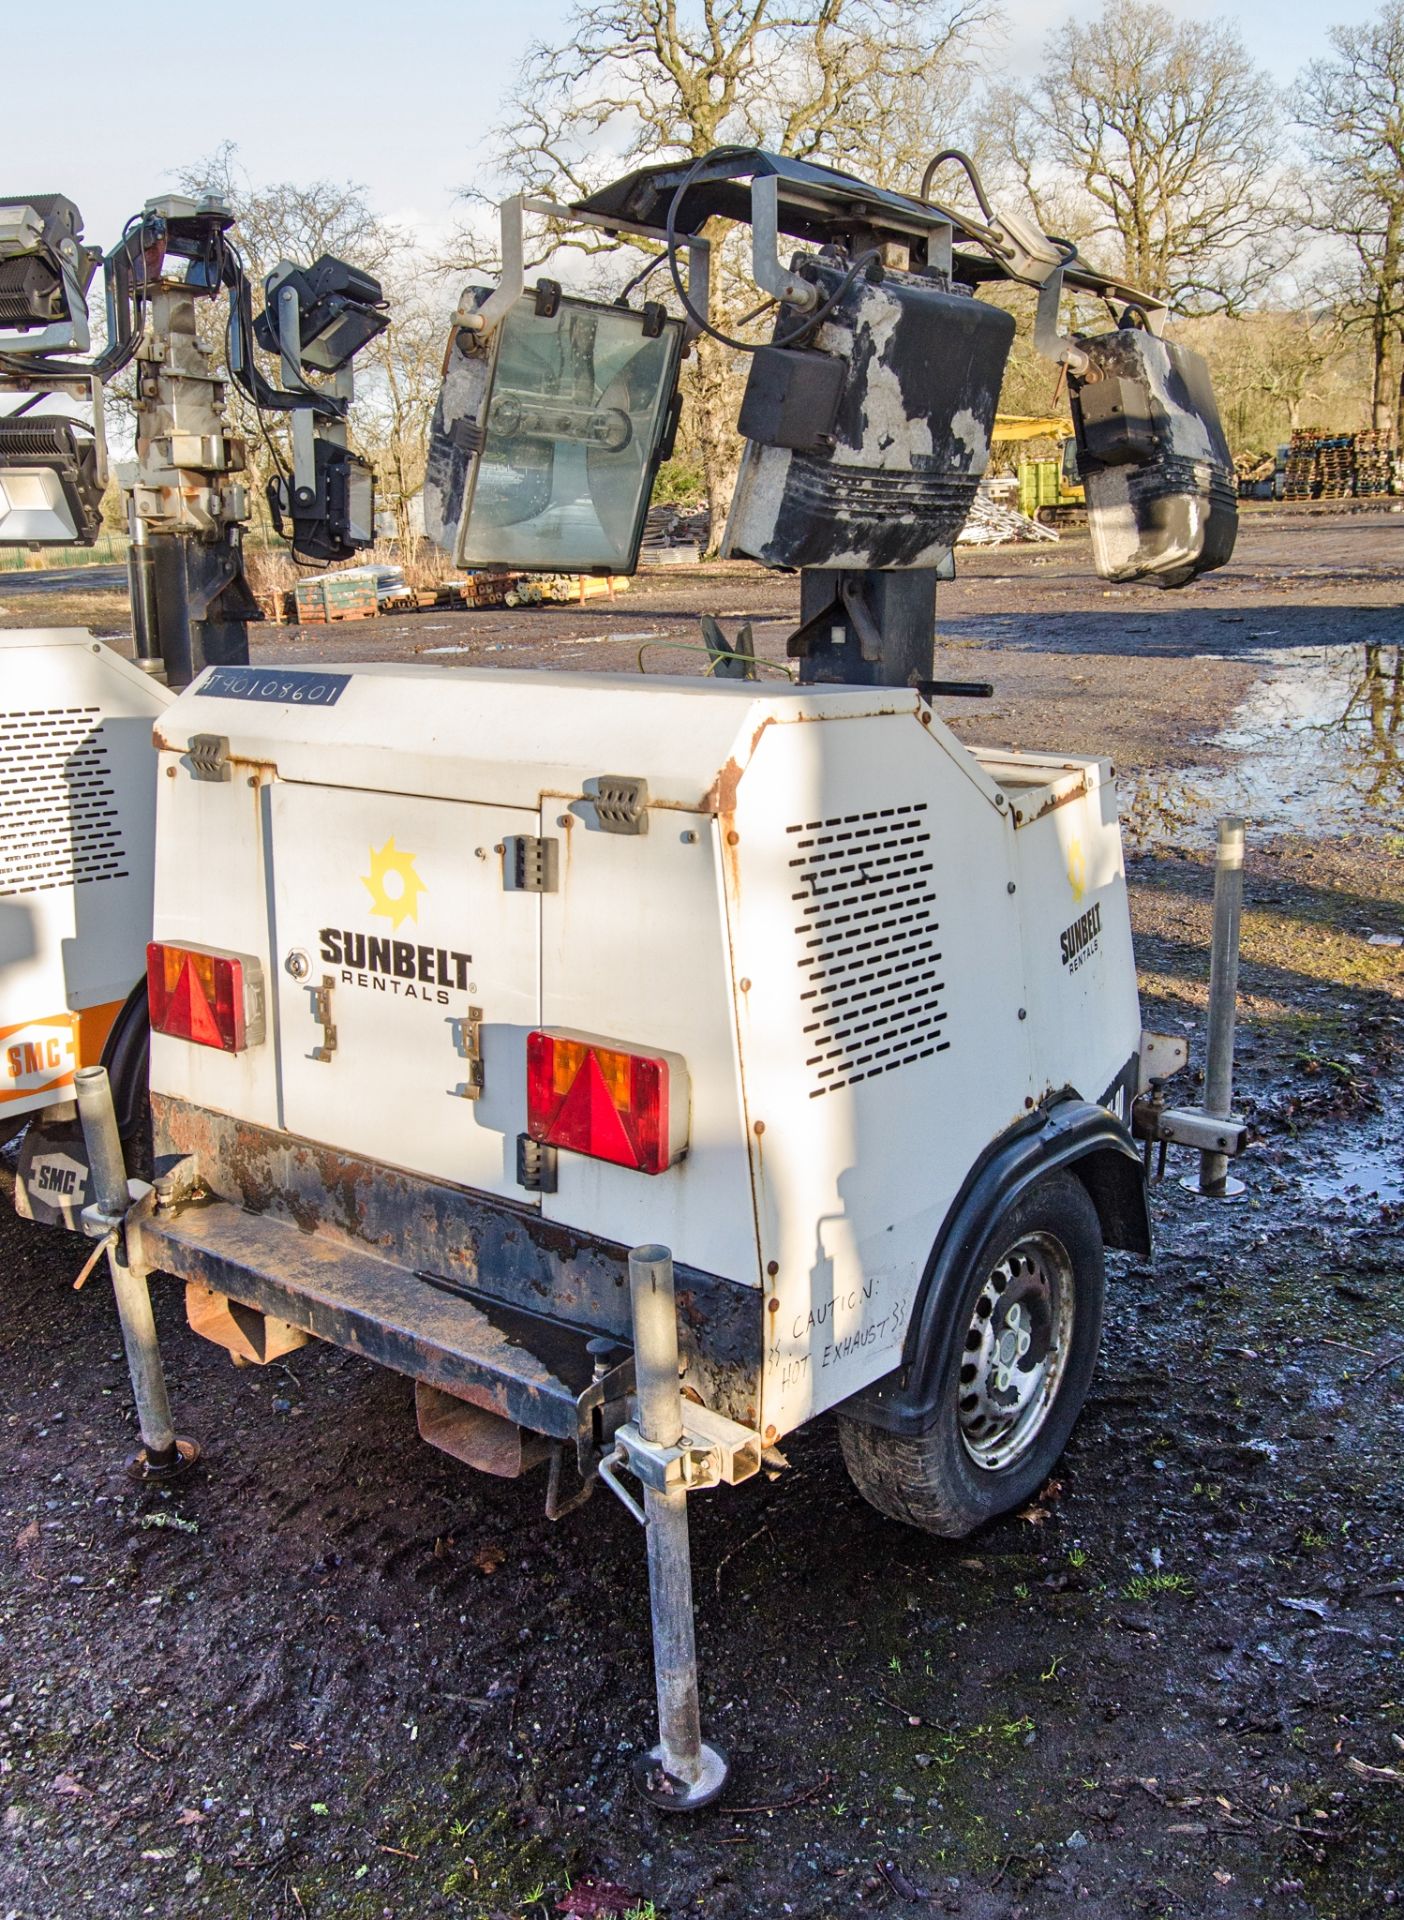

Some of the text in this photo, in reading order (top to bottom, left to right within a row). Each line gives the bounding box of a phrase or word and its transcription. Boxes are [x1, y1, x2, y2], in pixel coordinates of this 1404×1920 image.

[1060, 902, 1101, 965] SUNBELT
[319, 928, 472, 991] SUNBELT
[1069, 939, 1098, 975] RENTALS
[342, 970, 449, 1005] RENTALS
[7, 1038, 61, 1078] SMC
[38, 1165, 76, 1195] SMC
[822, 1318, 889, 1367] EXHAUST
